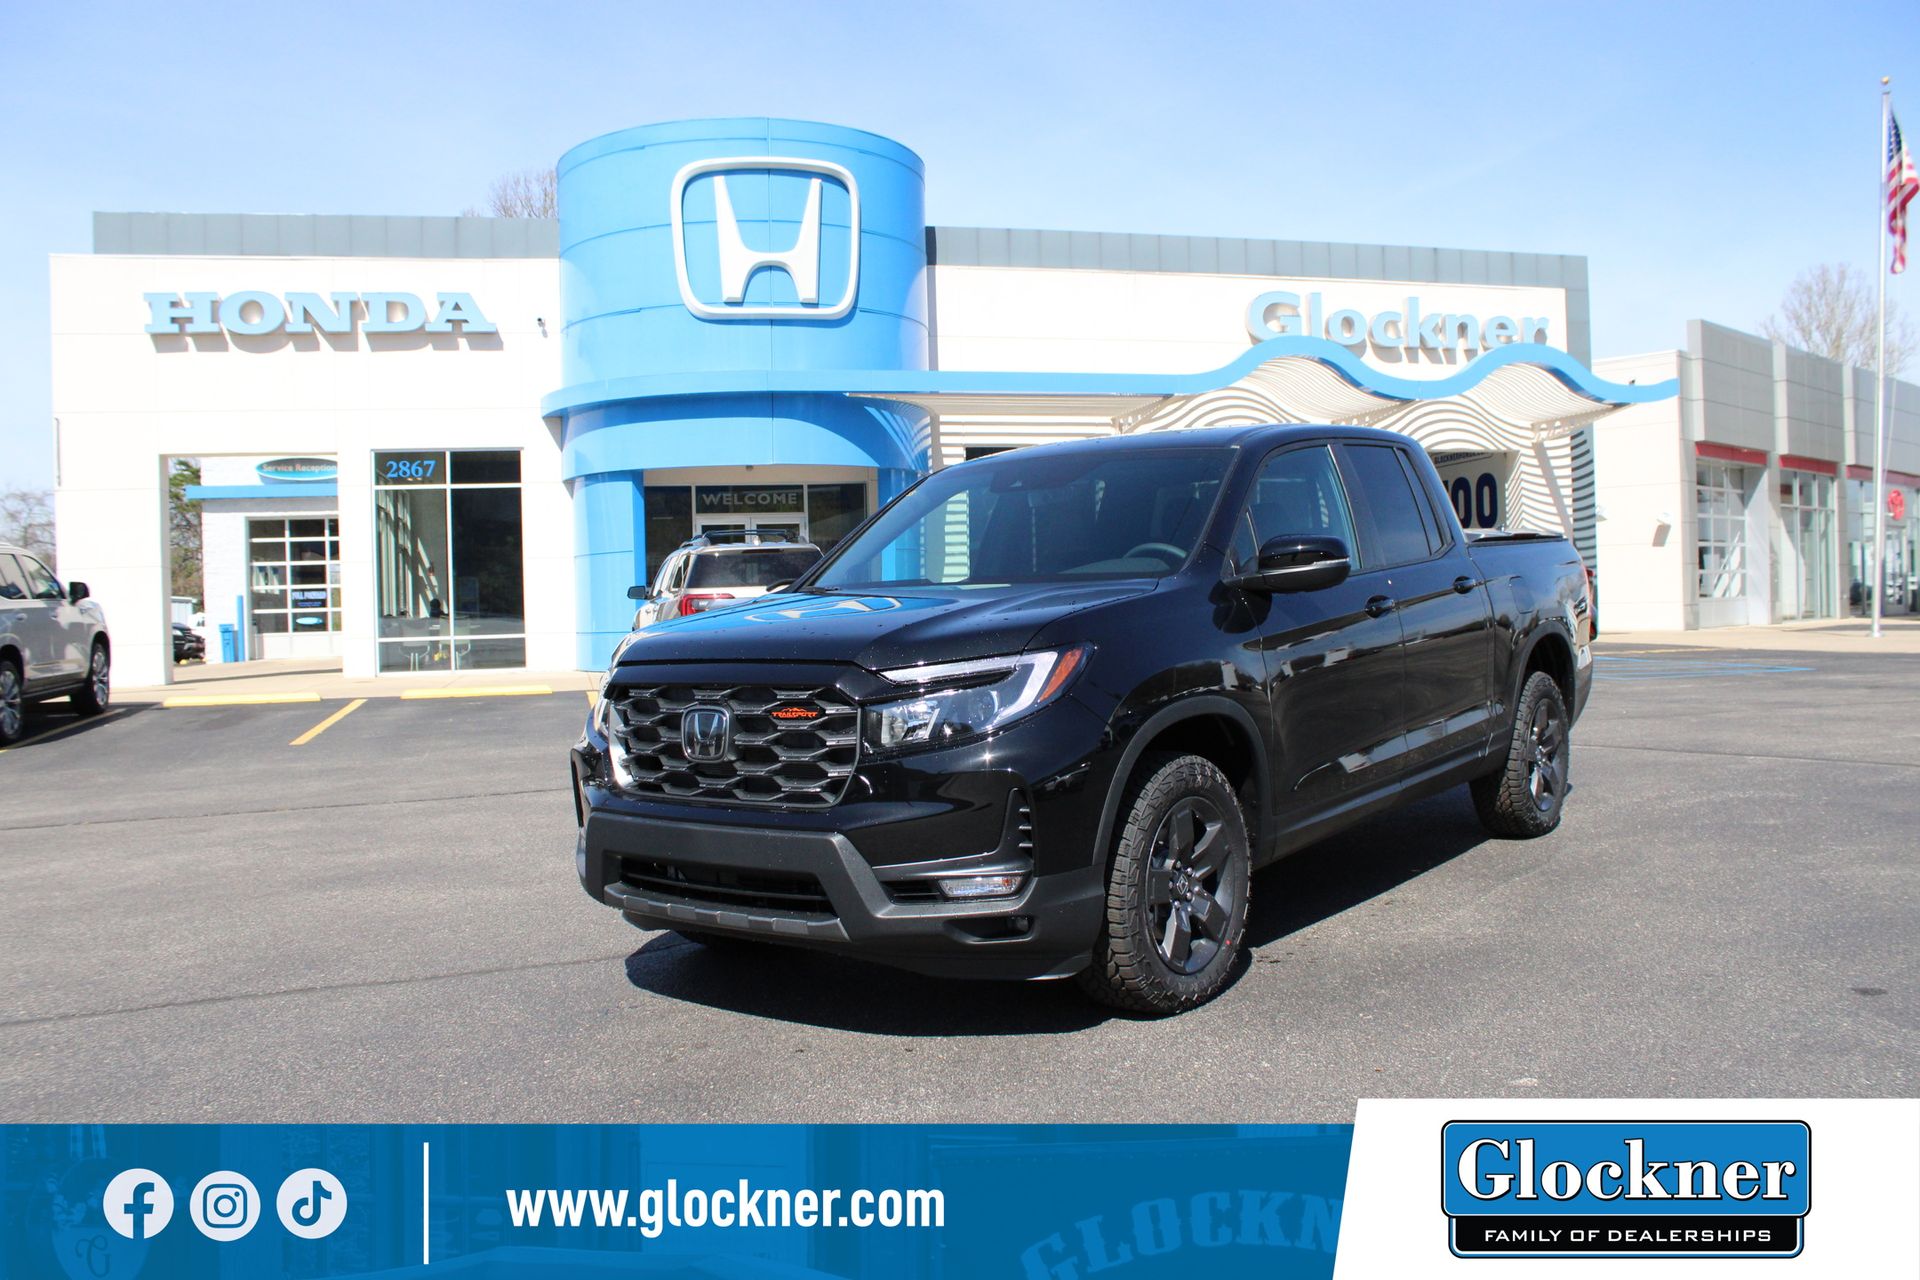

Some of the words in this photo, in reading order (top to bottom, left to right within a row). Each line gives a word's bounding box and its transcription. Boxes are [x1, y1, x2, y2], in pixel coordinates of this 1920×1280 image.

[143, 290, 497, 335] HONDA
[1247, 290, 1550, 350] Glockner
[386, 460, 437, 478] 2867
[702, 492, 798, 506] WELCOME
[1442, 472, 1498, 529] 00
